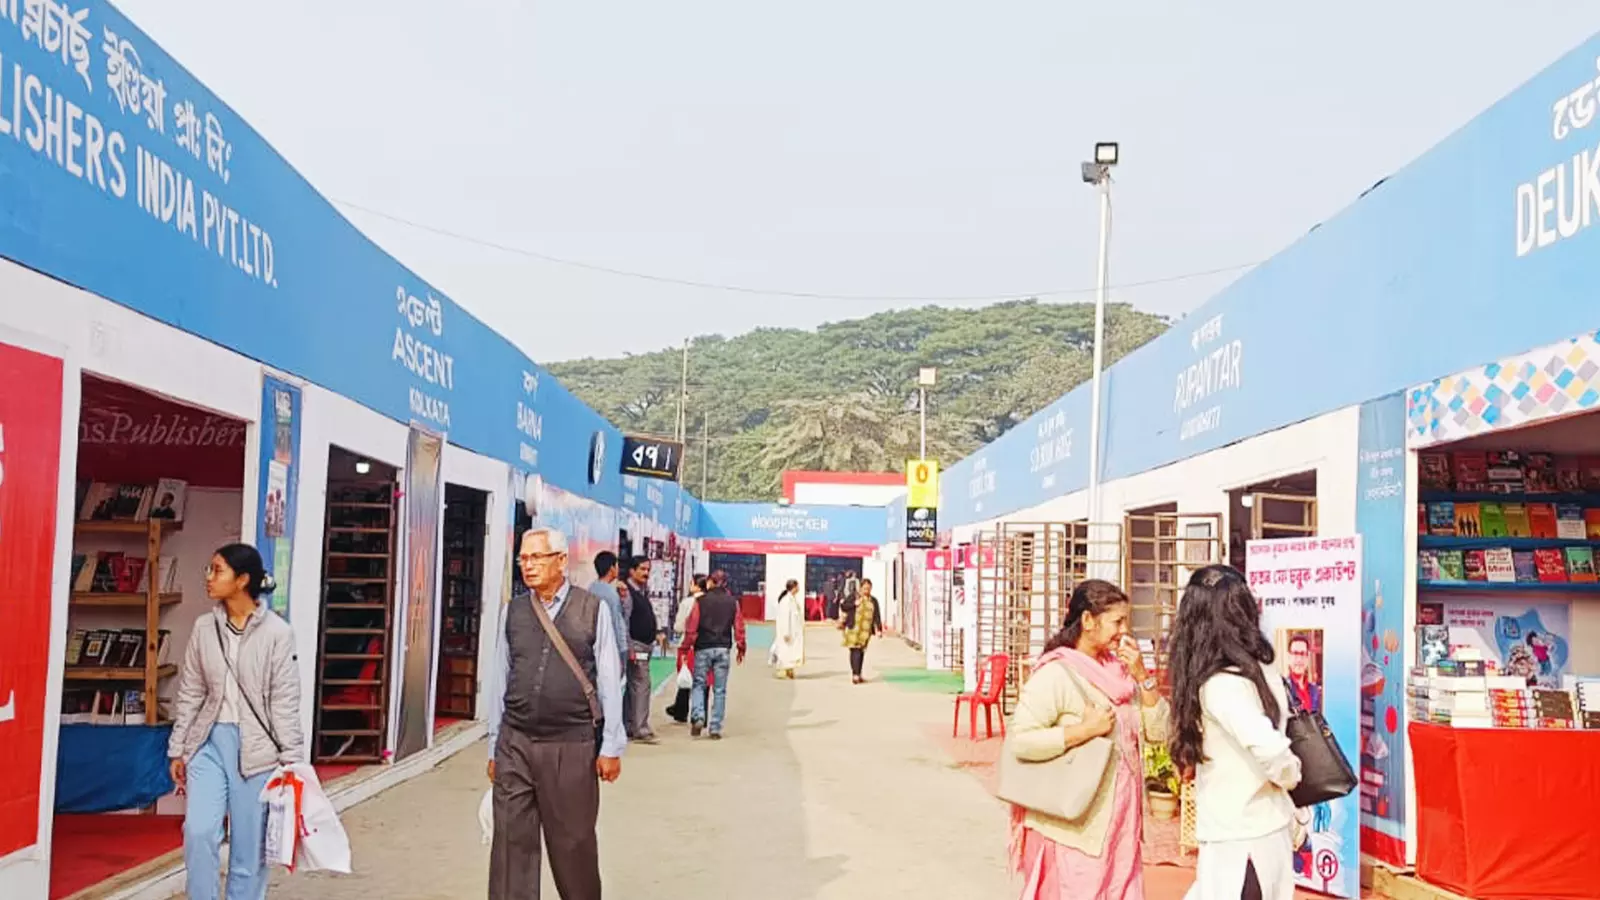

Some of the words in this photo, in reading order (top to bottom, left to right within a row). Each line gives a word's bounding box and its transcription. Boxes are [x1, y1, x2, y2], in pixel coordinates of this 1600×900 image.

[136, 144, 198, 241] INDIA
[392, 327, 454, 390] ASCENT
[409, 387, 450, 427] KOLKATA
[751, 514, 829, 531] WOODPECKER
